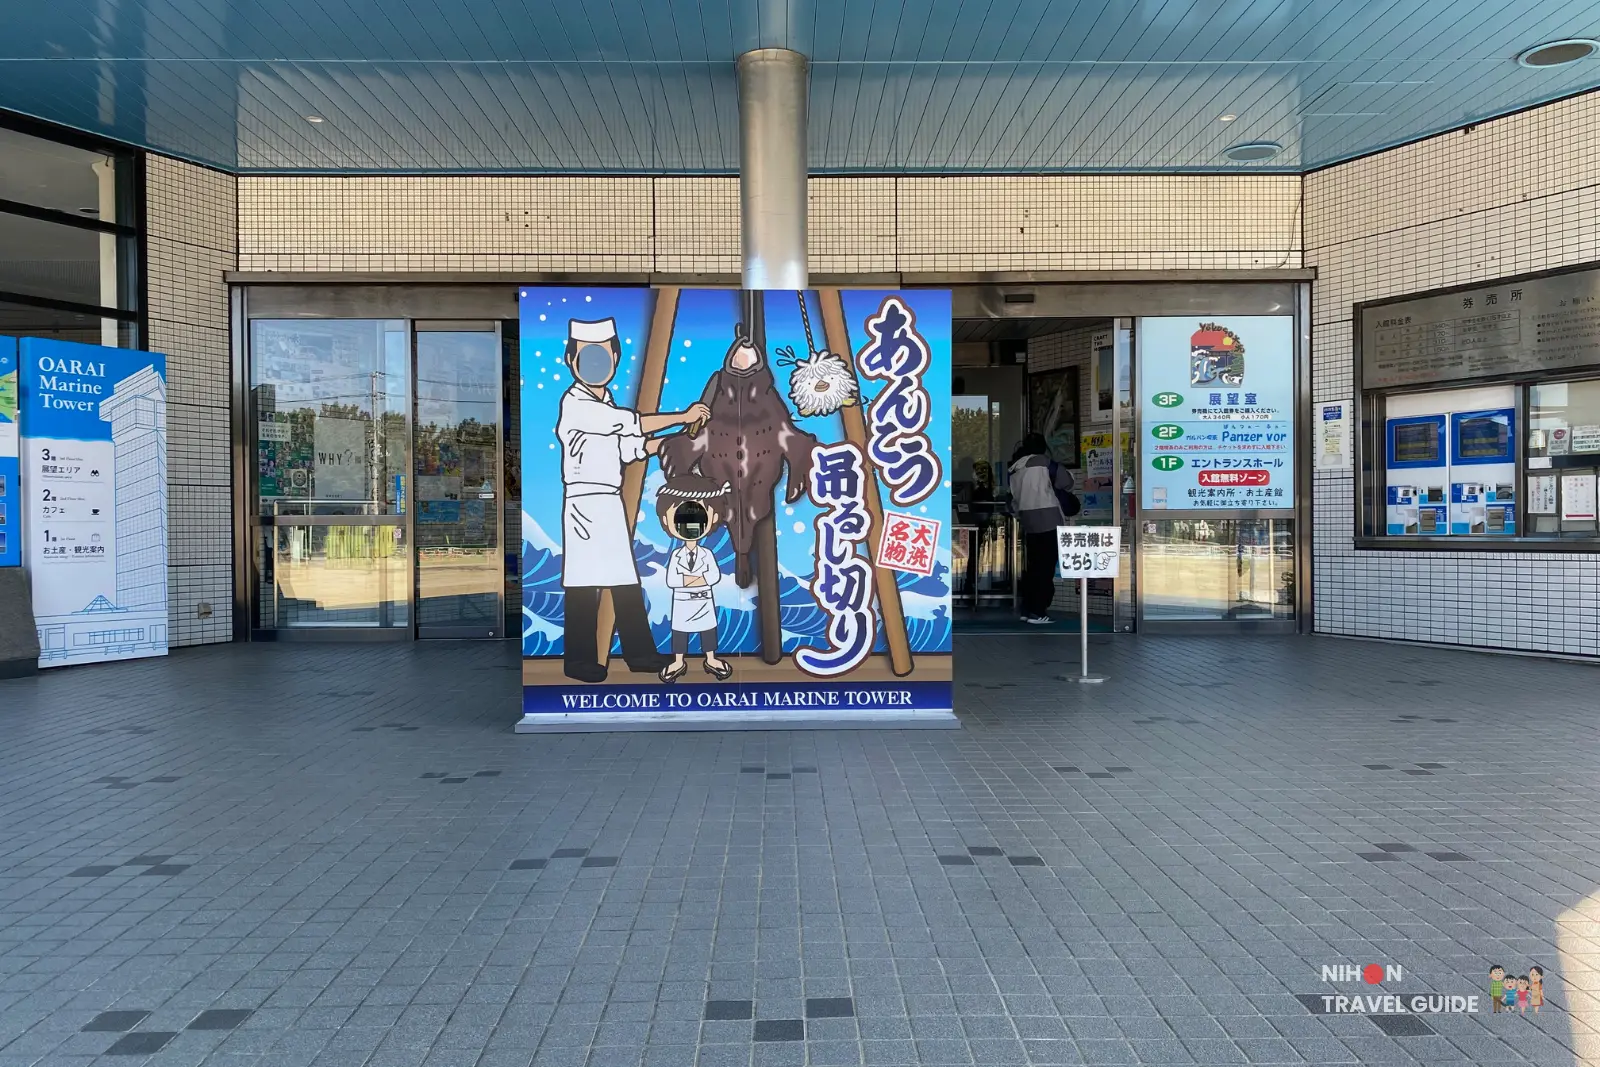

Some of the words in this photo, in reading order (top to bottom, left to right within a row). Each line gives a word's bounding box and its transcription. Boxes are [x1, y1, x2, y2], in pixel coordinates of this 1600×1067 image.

[1463, 289, 1523, 309] 券売所
[38, 356, 106, 378] OARAI
[39, 375, 102, 395] Marine
[39, 393, 94, 412] Tower
[862, 300, 936, 502] あんこう
[1158, 394, 1178, 406] 3F
[1208, 392, 1258, 406] 展望室
[1158, 426, 1178, 438] 2F
[1222, 430, 1263, 442] Panzer
[1266, 433, 1287, 442] vor
[41, 465, 81, 474] 展望エリア
[1159, 457, 1178, 469] 1F
[1191, 458, 1284, 469] エントランスホール
[1201, 473, 1267, 483] 入館無料ゾーン
[1187, 488, 1284, 498] 観光案内所・お土産館
[42, 506, 66, 514] カフェ
[884, 520, 910, 561] 名物
[907, 525, 931, 568] 大洗
[1060, 532, 1114, 548] 券売機は
[43, 545, 105, 554] お土産・観光案内
[800, 447, 869, 671] 吊るし切り
[1061, 552, 1093, 571] こちら
[562, 693, 660, 709] WELCOME
[665, 693, 692, 708] TO
[696, 692, 758, 707] OARAI
[763, 692, 840, 706] MARINE
[844, 691, 913, 706] TOWER
